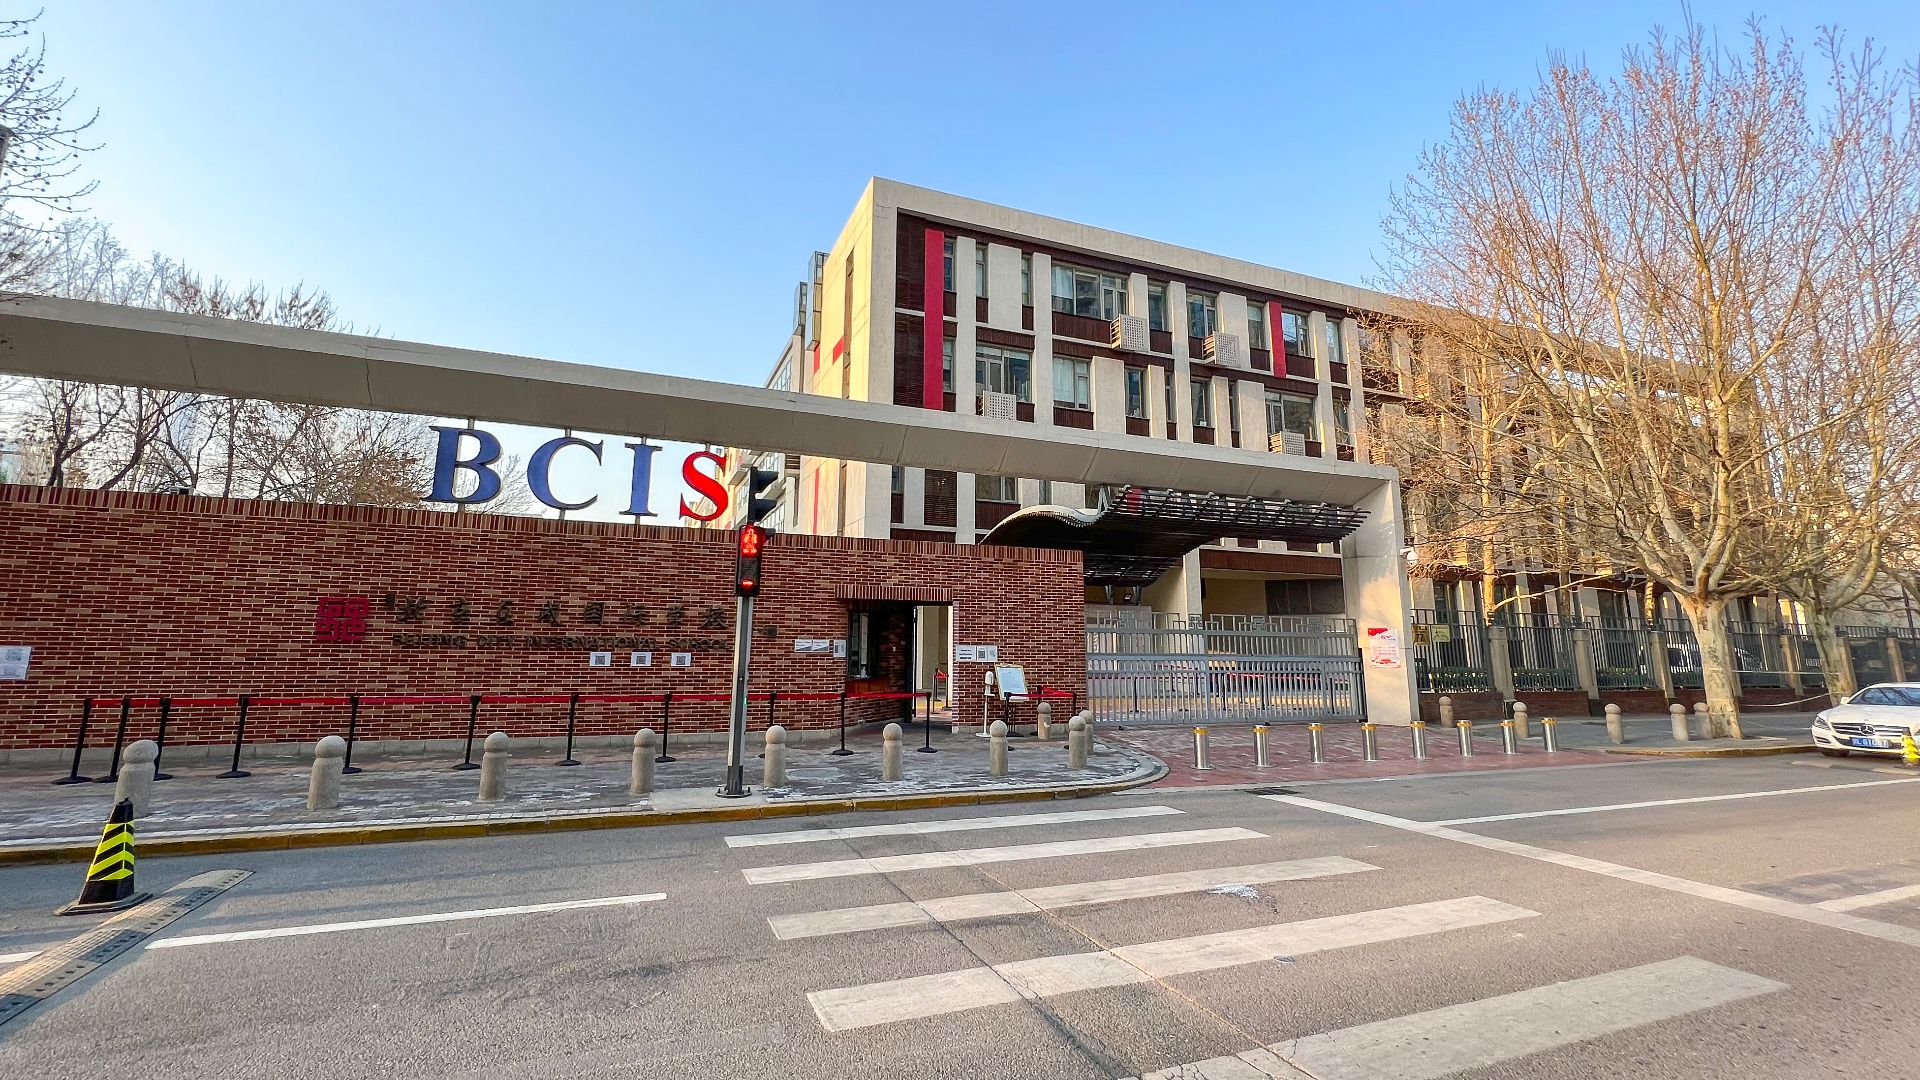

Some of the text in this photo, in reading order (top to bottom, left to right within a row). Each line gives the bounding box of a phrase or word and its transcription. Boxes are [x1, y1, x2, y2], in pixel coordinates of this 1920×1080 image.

[423, 425, 729, 521] BCIS
[392, 633, 729, 649] BEIJING CITY INTERNATIONAL SCHOOL
